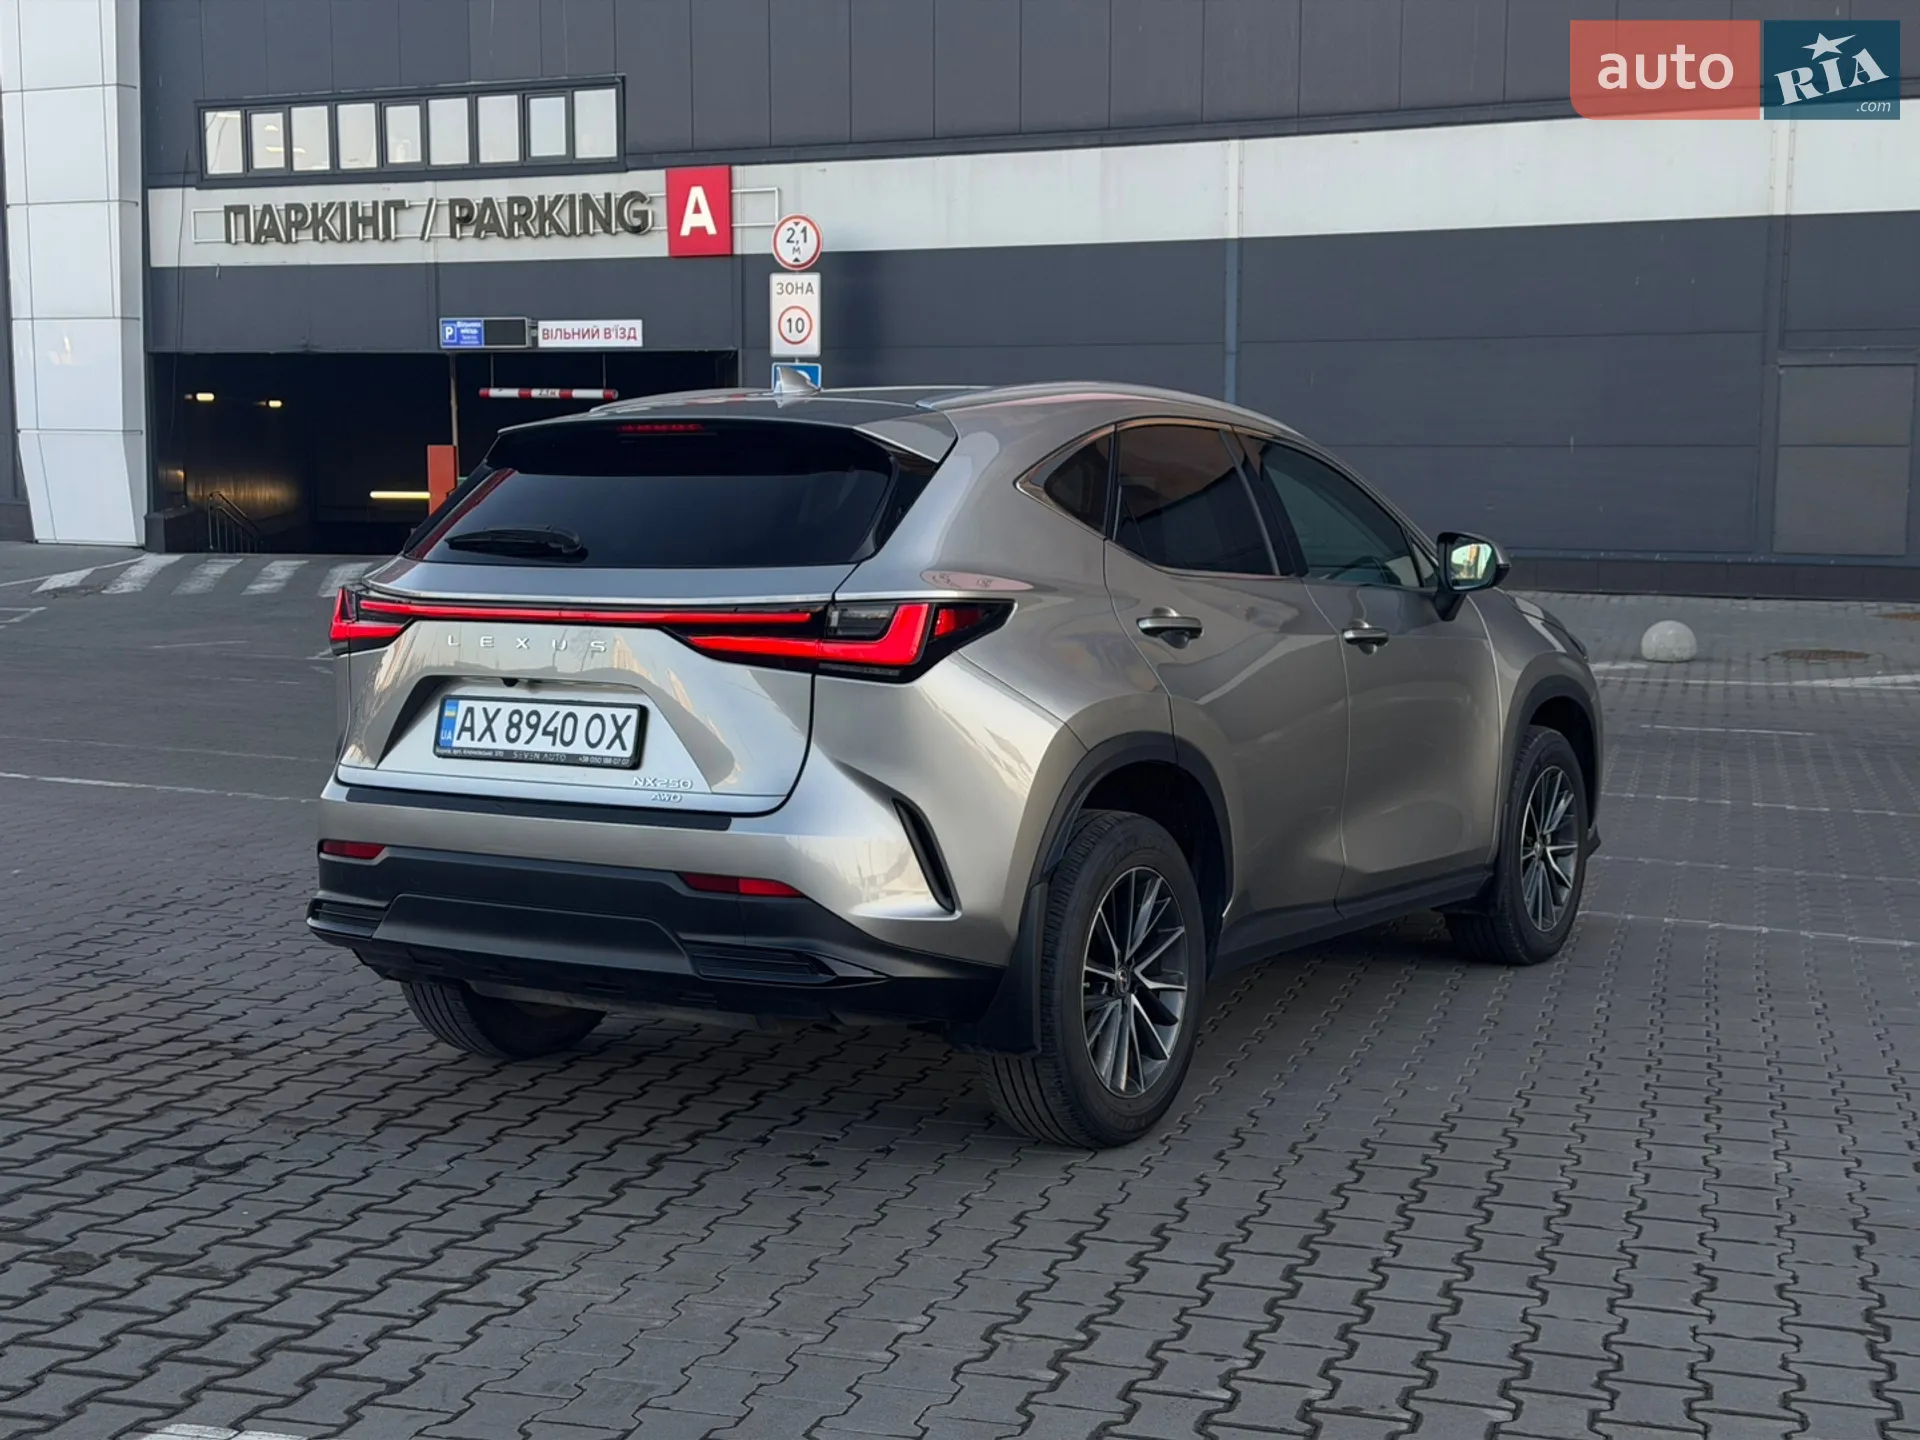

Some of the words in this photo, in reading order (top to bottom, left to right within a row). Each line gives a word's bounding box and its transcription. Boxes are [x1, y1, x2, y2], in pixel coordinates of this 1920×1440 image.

[224, 200, 409, 245] ПАРКІНГ
[448, 190, 653, 242] PARKING
[786, 225, 808, 245] 2,1
[776, 282, 815, 296] ЗОНА
[541, 325, 600, 341] ВІЛЬНИЙ
[603, 325, 638, 342] В'ЇЗД
[786, 317, 806, 334] 10
[447, 634, 607, 653] LEXUS
[440, 731, 452, 741] UA
[456, 706, 502, 743] AX
[504, 708, 578, 748] 8940
[584, 713, 632, 751] OX
[651, 793, 683, 803] AWD
